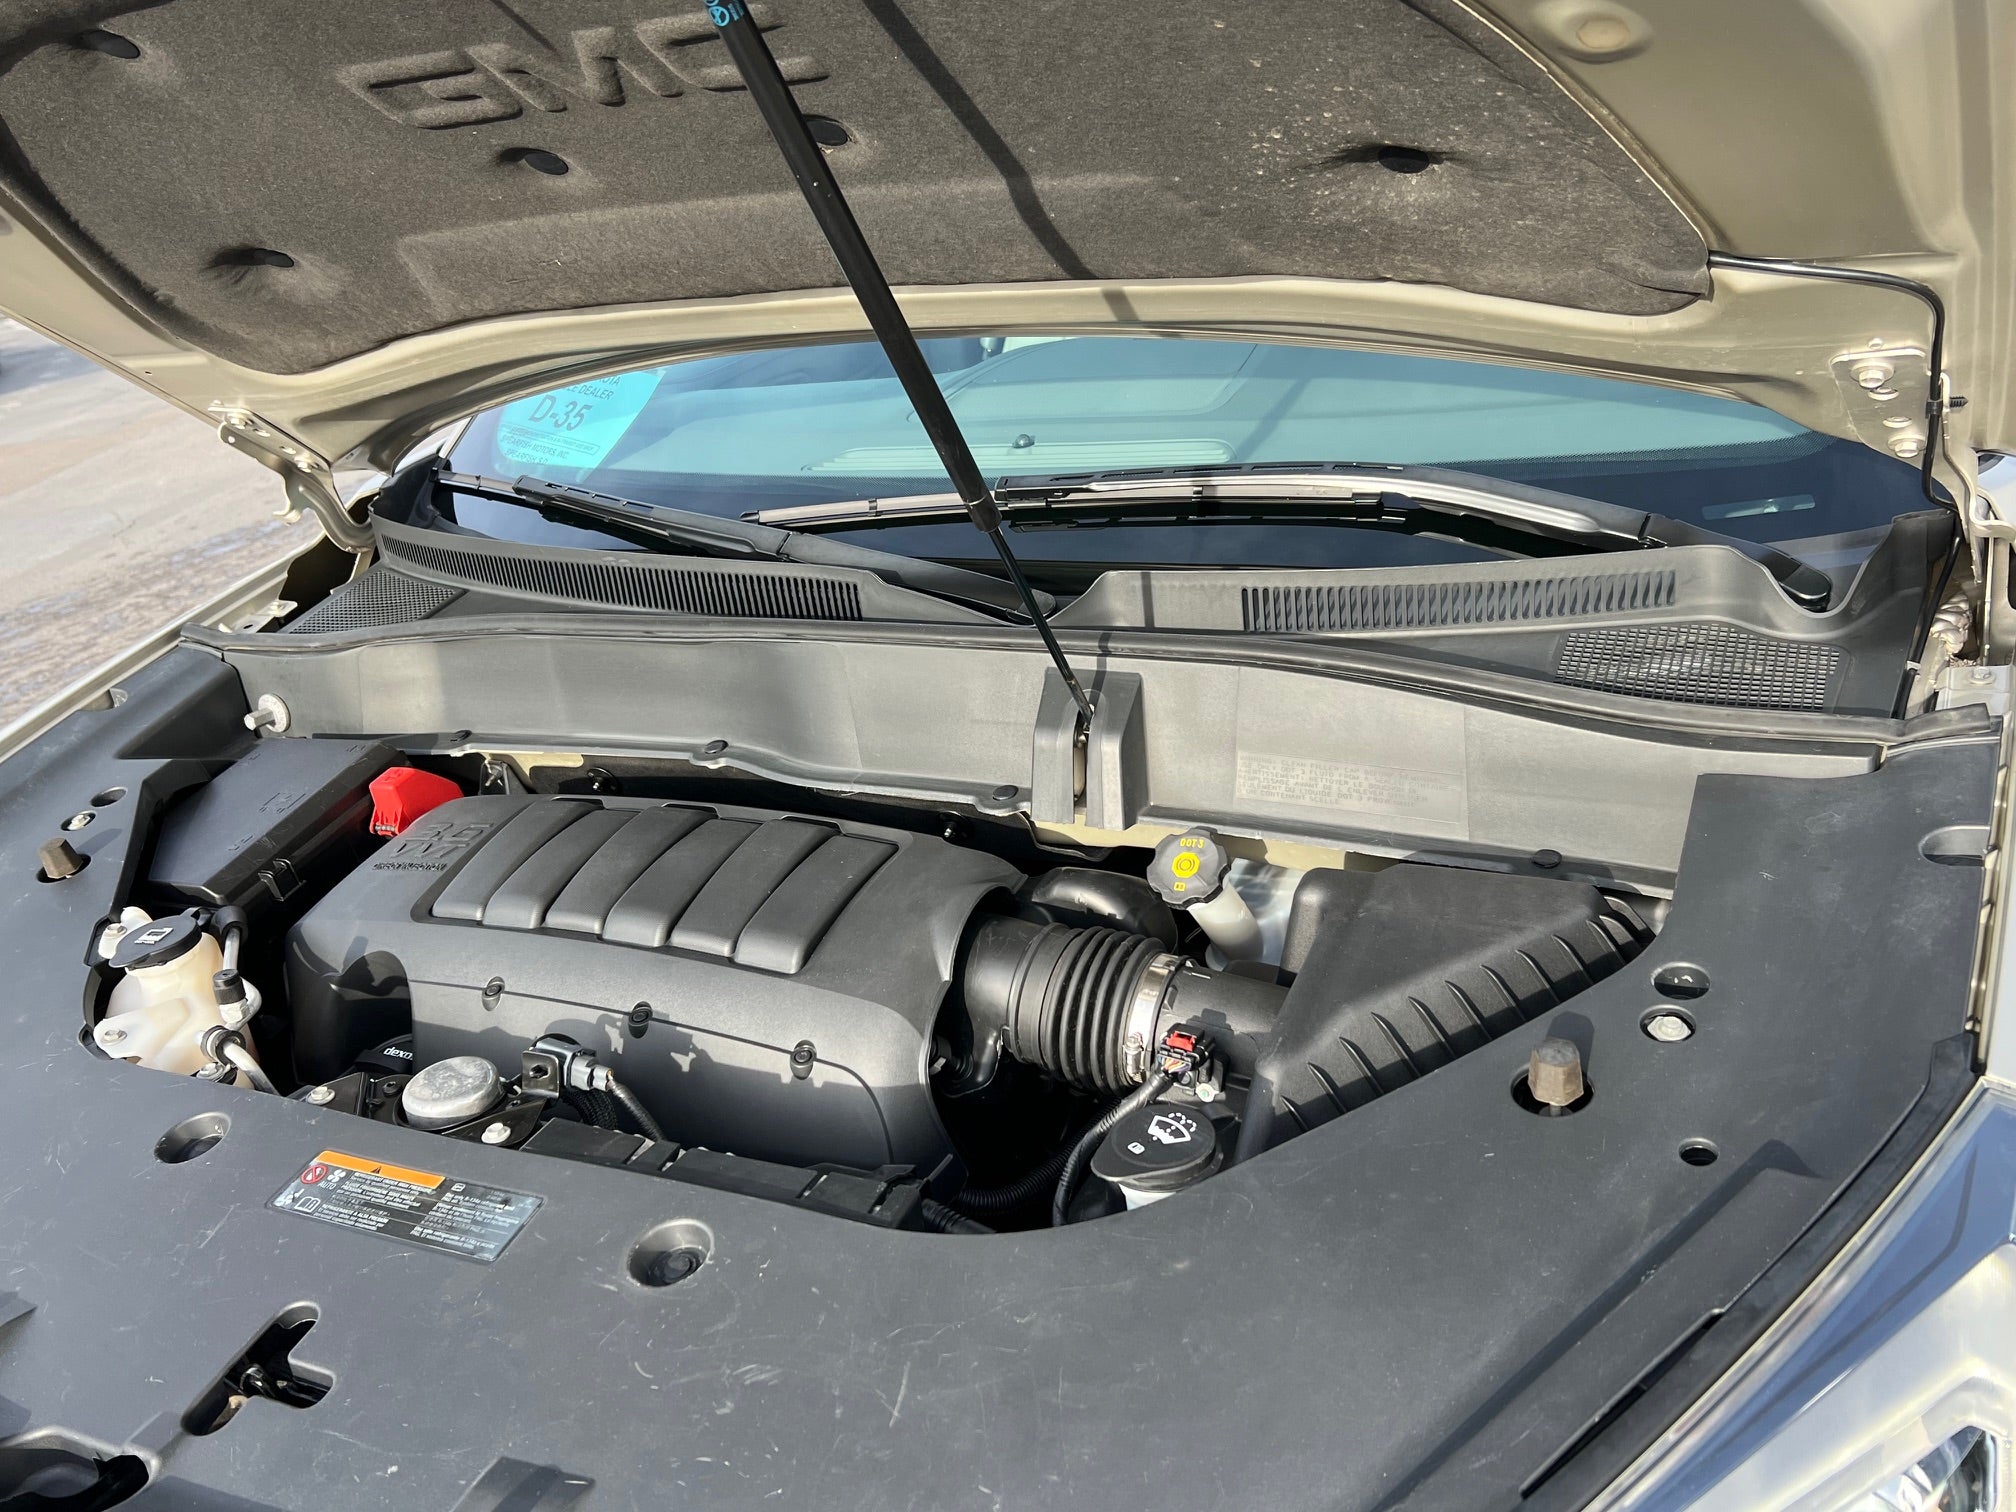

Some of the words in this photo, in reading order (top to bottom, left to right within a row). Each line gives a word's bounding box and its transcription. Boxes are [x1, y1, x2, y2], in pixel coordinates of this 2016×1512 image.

[335, 2, 830, 130] GMC
[579, 384, 615, 400] DEALER
[528, 394, 594, 432] D-35
[1180, 838, 1197, 848] DOT
[1198, 837, 1204, 848] 3
[383, 1047, 412, 1060] dexo
[317, 1180, 337, 1190] AUTO
